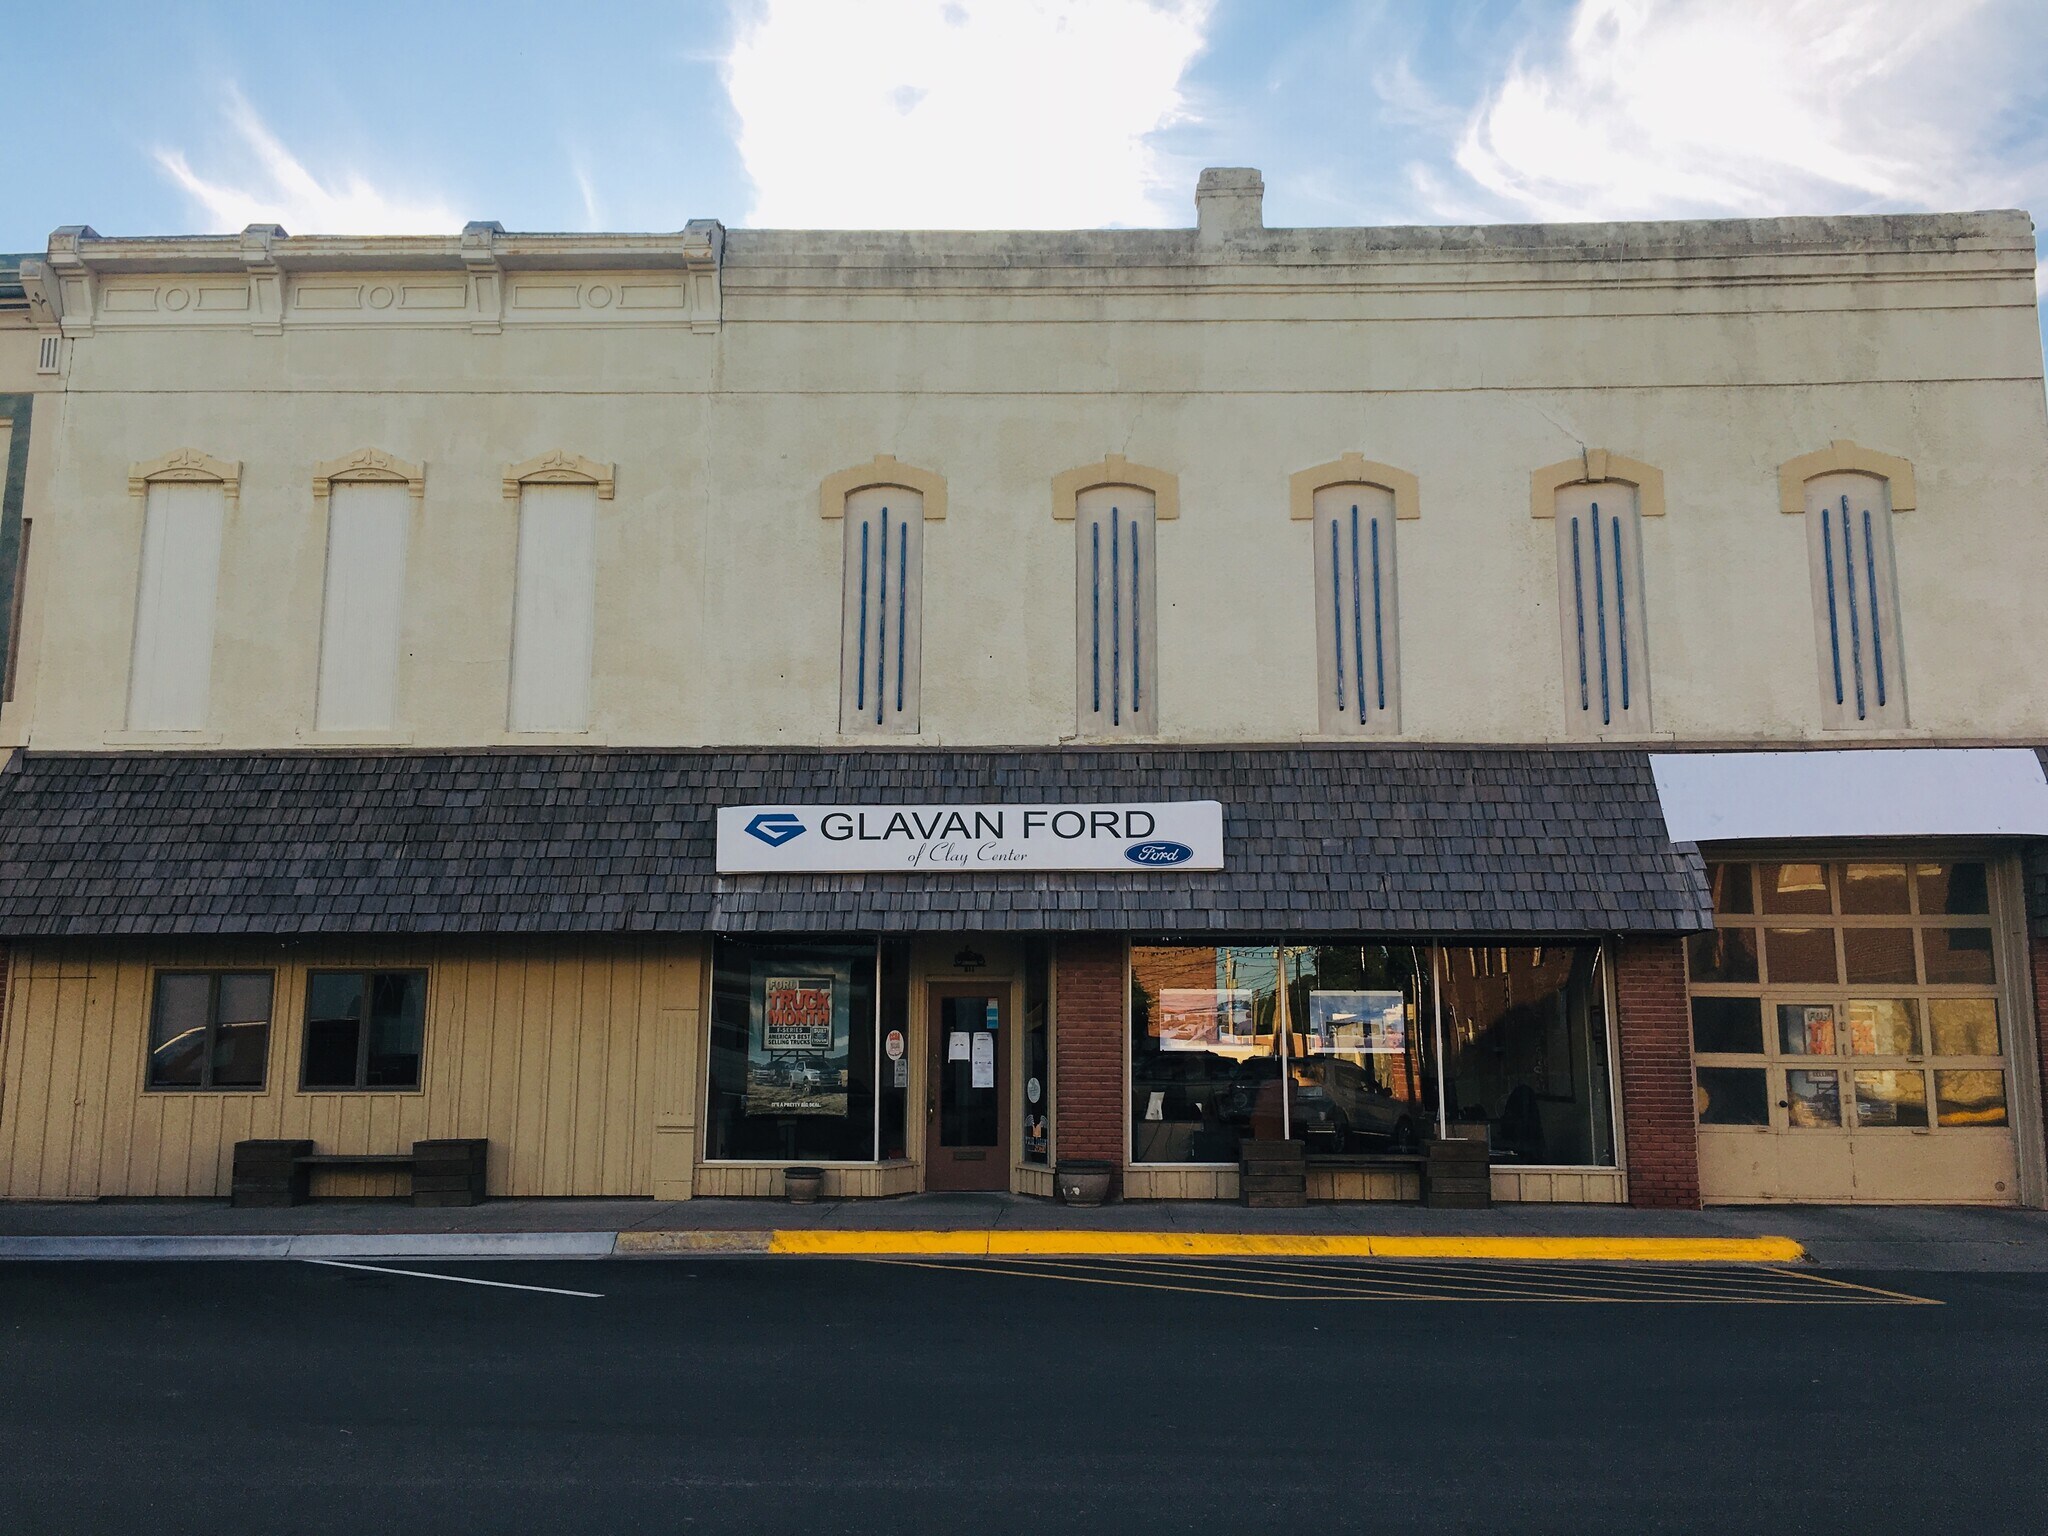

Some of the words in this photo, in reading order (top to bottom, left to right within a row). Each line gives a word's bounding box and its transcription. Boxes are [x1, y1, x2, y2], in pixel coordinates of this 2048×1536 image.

[820, 811, 1004, 841] GLAVAN
[1023, 810, 1156, 839] FORD
[907, 842, 927, 867] of
[929, 842, 968, 866] Clay
[976, 841, 1028, 862] Center
[1137, 844, 1179, 862] Ford
[769, 980, 797, 990] FORD
[768, 989, 830, 1010] TRUCK
[768, 1009, 830, 1026] MONTH
